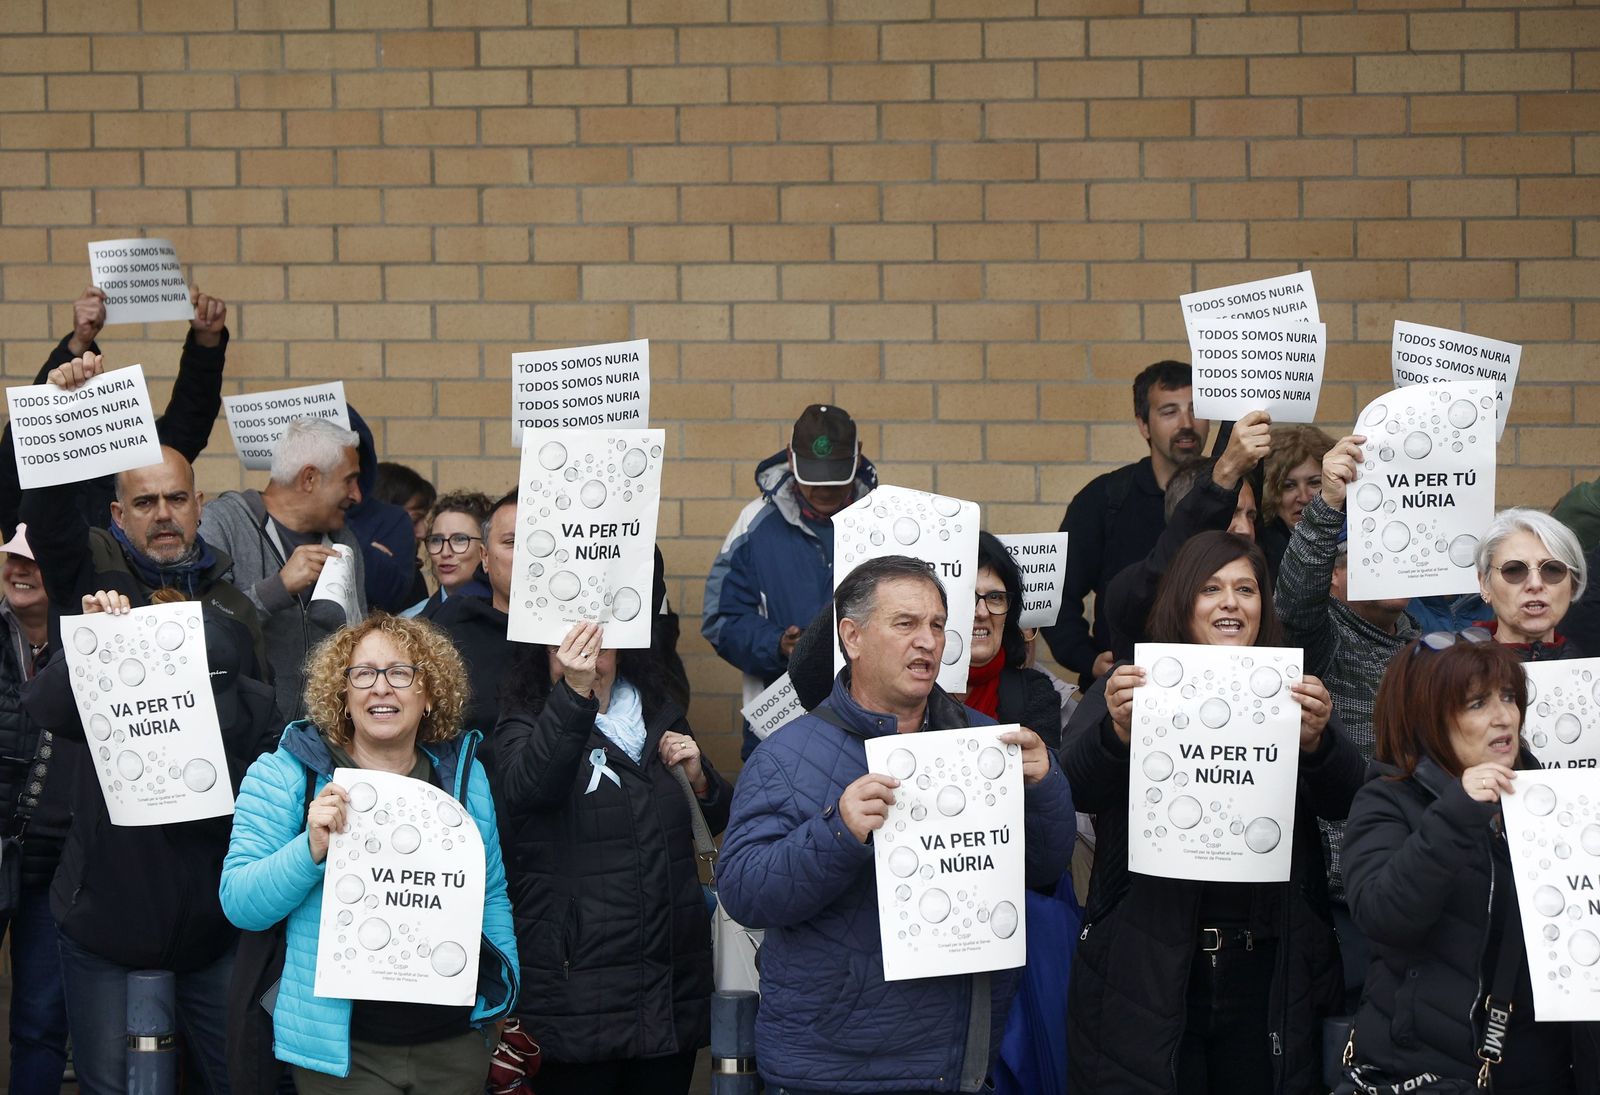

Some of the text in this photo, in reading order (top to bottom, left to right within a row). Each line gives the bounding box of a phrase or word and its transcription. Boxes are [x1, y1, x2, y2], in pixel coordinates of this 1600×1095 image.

[95, 249, 128, 258] TODOS
[130, 248, 158, 256] SOMOS
[97, 264, 128, 274] TODOS
[130, 264, 159, 272] SOMOS
[99, 278, 185, 289] TODOS SOMOS NURIA
[104, 293, 186, 305] ODOS SOMOS NURIA
[1188, 284, 1304, 314] TODOS SOMOS NURIA
[1273, 301, 1308, 316] NURIA
[1198, 330, 1317, 344] TODOS SOMOS NURIA
[1198, 350, 1316, 363] TODOS SOMOS NURIA
[1399, 332, 1510, 364] TODOS SOMOS NURIA
[518, 352, 639, 374] TODOS SOMOS NURIA
[1397, 351, 1507, 382] TODOS SOMOS NURIA
[519, 372, 640, 392] TODOS SOMOS NURIA
[1198, 369, 1314, 382] TODOS SOMOS NURIA
[1396, 369, 1429, 384] TODOS
[13, 379, 135, 408] TODOS SOMOS NURIA
[230, 393, 336, 413] TODOS SOMOS NURIA
[518, 391, 640, 410] TODOS SOMOS NURIA
[1198, 388, 1311, 400] TODOS SOMOS NURIA
[16, 398, 139, 427] TODOS SOMOS NURIA
[518, 409, 640, 428] TODOS SOMOS NURIA
[18, 416, 144, 446] TODOS SOMOS NURIA
[233, 418, 265, 429] TODOS
[237, 433, 268, 443] TODOS
[21, 435, 148, 465] TODOS SOMOS NURIA
[242, 449, 272, 457] TODOS
[1387, 469, 1476, 488] VA PER TÚ
[1402, 491, 1455, 508] NÚRIA
[562, 519, 640, 538] VA PER TÚ
[576, 542, 620, 560] NÚRIA
[1023, 545, 1057, 555] NURIA
[941, 560, 961, 577] TÚ
[1022, 563, 1056, 574] NURIA
[1022, 582, 1054, 592] NURIA
[111, 690, 195, 717] VA PER TÚ
[751, 695, 779, 720] TODOS
[129, 718, 180, 737] NÚRIA
[761, 707, 789, 732] TODOS
[1180, 744, 1278, 762] VA PER TÚ
[1196, 765, 1254, 785] NÚRIA
[920, 825, 1009, 850] VA PER TÚ
[940, 853, 994, 873] NÚRIA
[371, 868, 465, 888] VA PER TÚ
[1567, 875, 1593, 890] VA
[386, 889, 442, 909] NÚRIA
